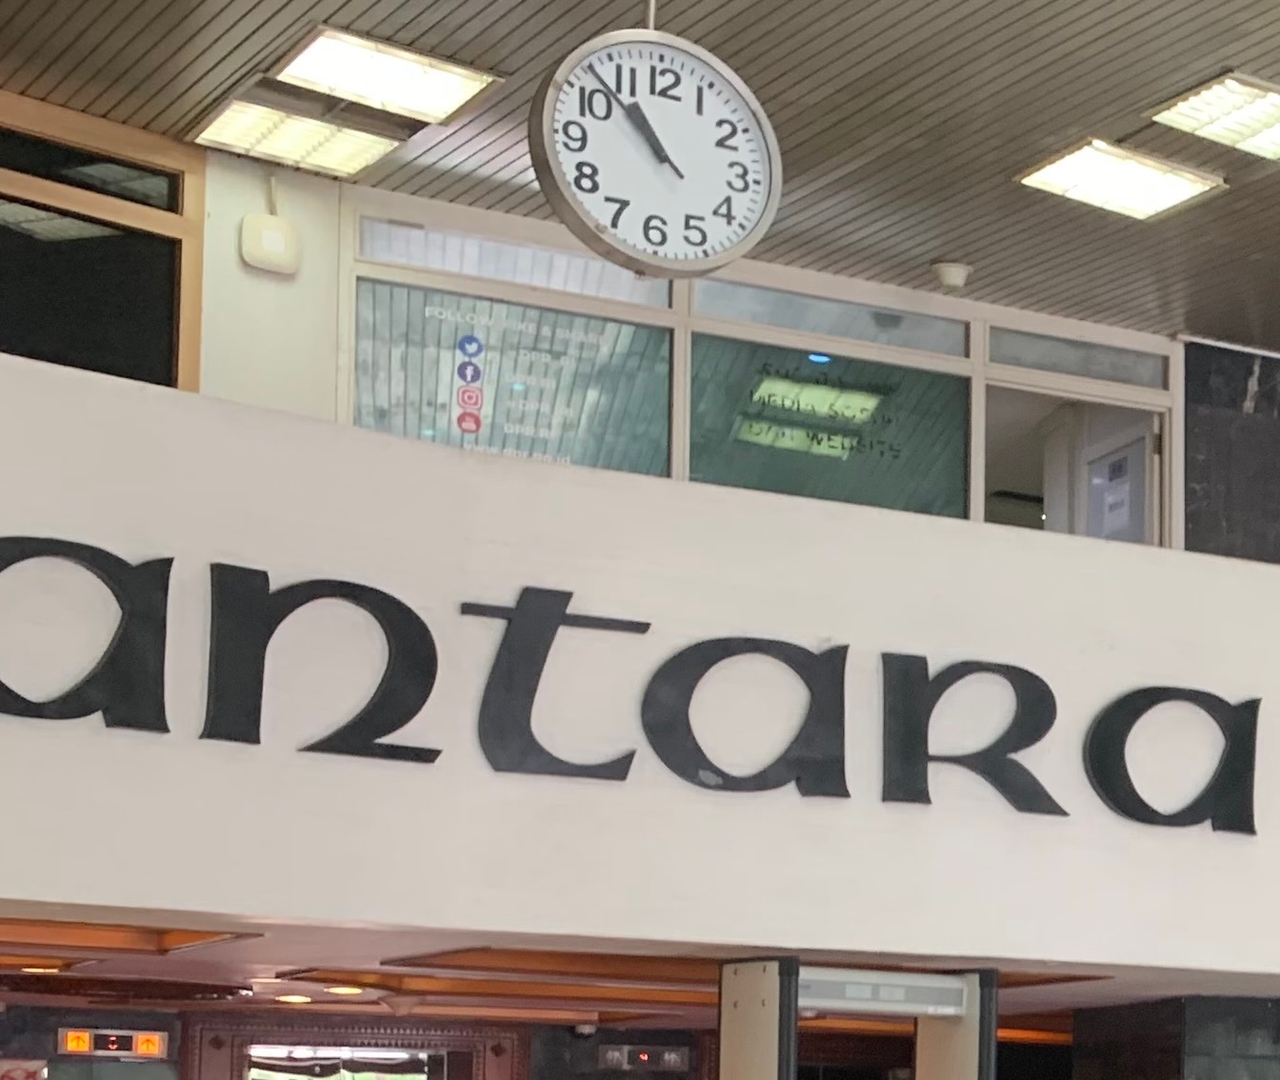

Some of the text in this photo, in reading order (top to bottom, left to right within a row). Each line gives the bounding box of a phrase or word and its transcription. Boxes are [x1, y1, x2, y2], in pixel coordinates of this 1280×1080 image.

[615, 63, 638, 98] 11
[649, 65, 683, 102] 12
[579, 85, 613, 121] 10
[696, 84, 704, 116] 1
[561, 119, 588, 153] 9
[714, 118, 739, 151] 2
[573, 160, 600, 194] 8
[725, 160, 750, 193] 3
[603, 195, 631, 229] 7
[711, 195, 736, 226] 4
[642, 214, 668, 247] 6
[683, 213, 708, 247] 5
